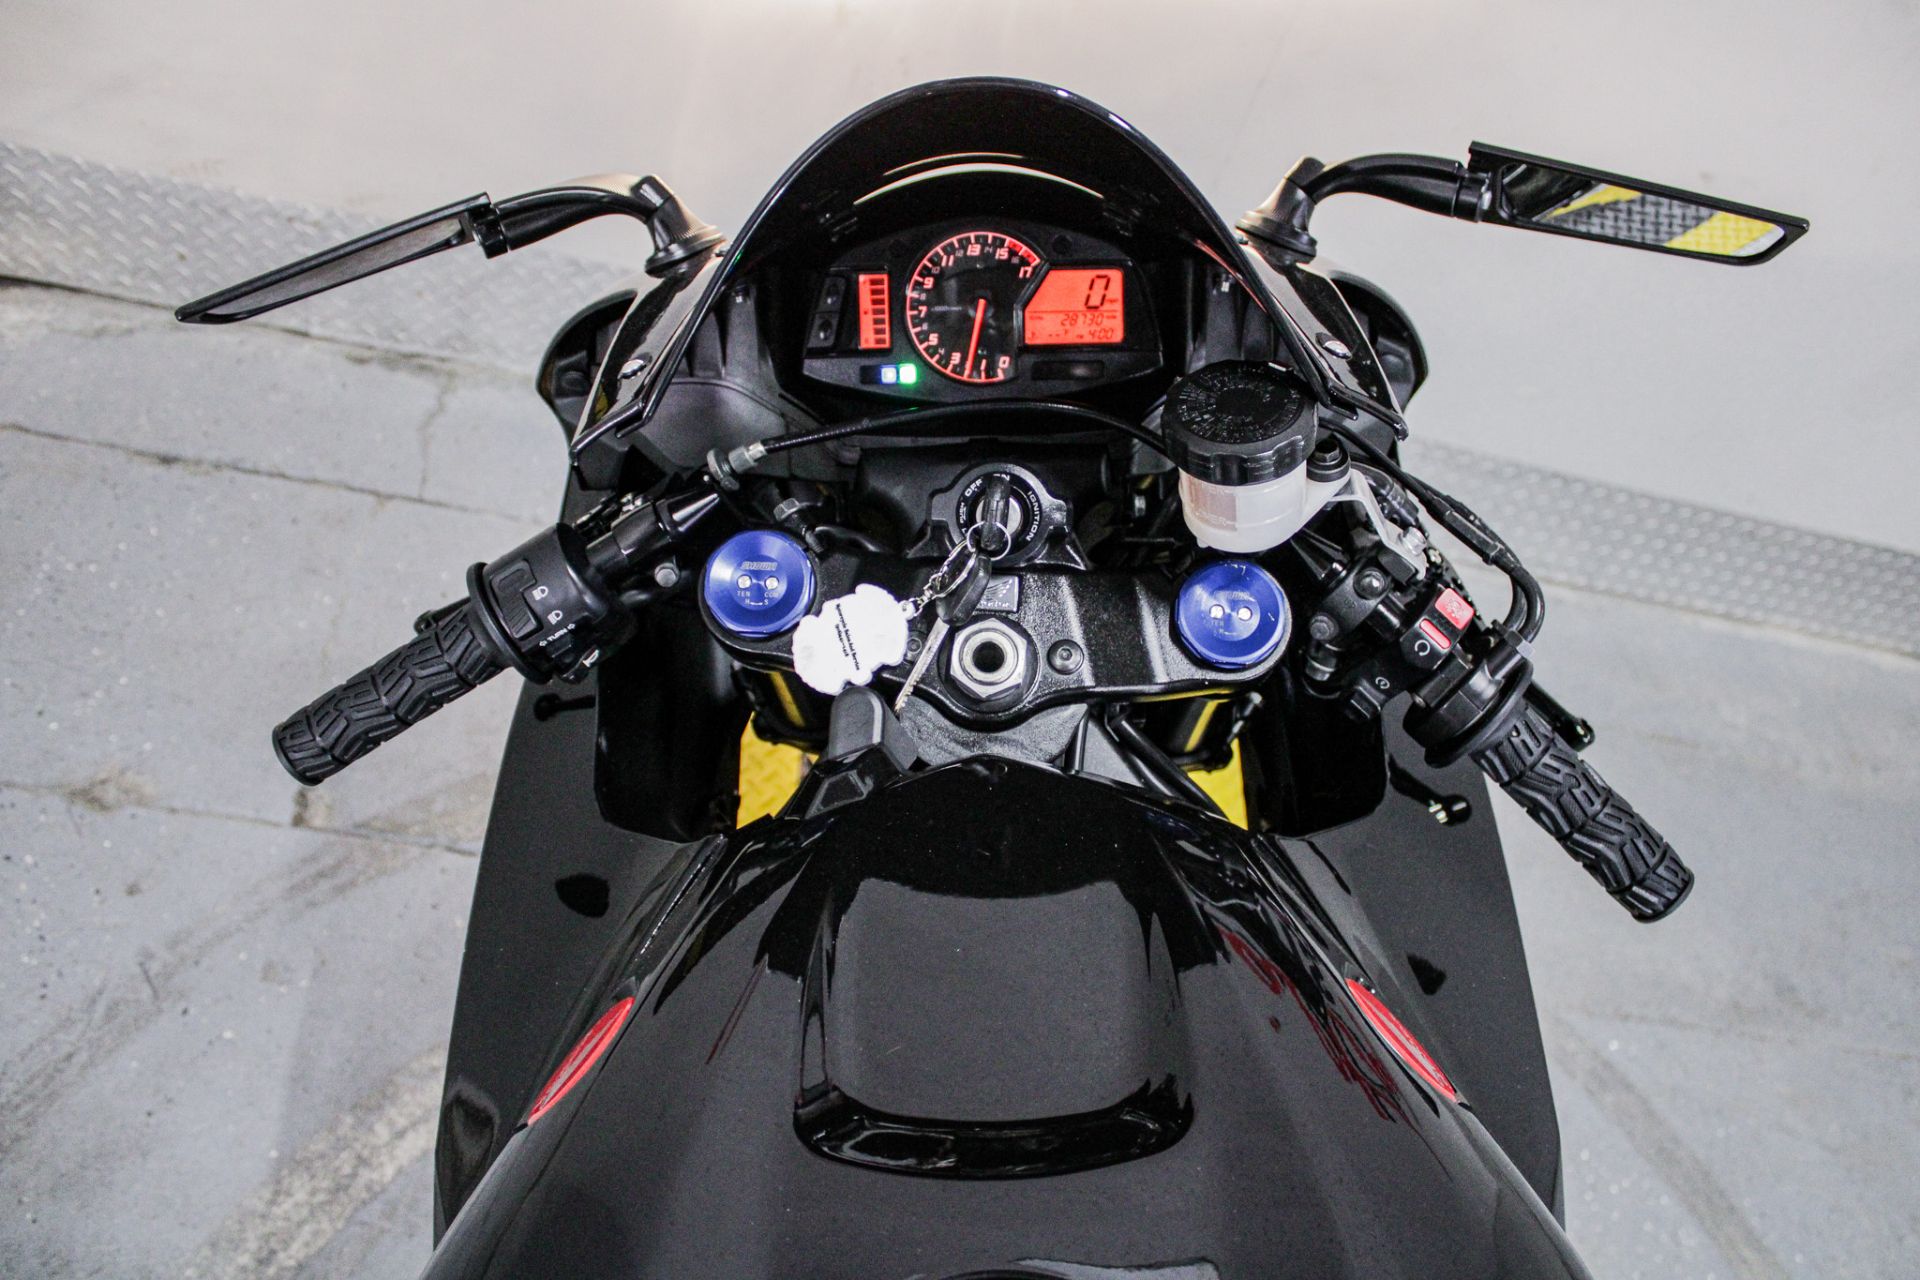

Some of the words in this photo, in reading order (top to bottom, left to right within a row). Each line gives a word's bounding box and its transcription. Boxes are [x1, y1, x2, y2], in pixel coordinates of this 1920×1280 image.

[966, 243, 982, 256] 13
[995, 247, 1009, 260] 15
[941, 254, 955, 267] 11
[931, 266, 941, 274] 10
[1019, 266, 1033, 278] 17
[923, 277, 935, 289] 9
[1085, 274, 1111, 310] 0
[918, 305, 928, 318] 7
[928, 333, 939, 345] 5
[950, 352, 961, 365] 3
[980, 359, 987, 371] 1
[998, 355, 1010, 369] 0
[964, 478, 983, 497] OFF
[1026, 491, 1041, 542] IGNITION
[547, 628, 568, 641] TURN
